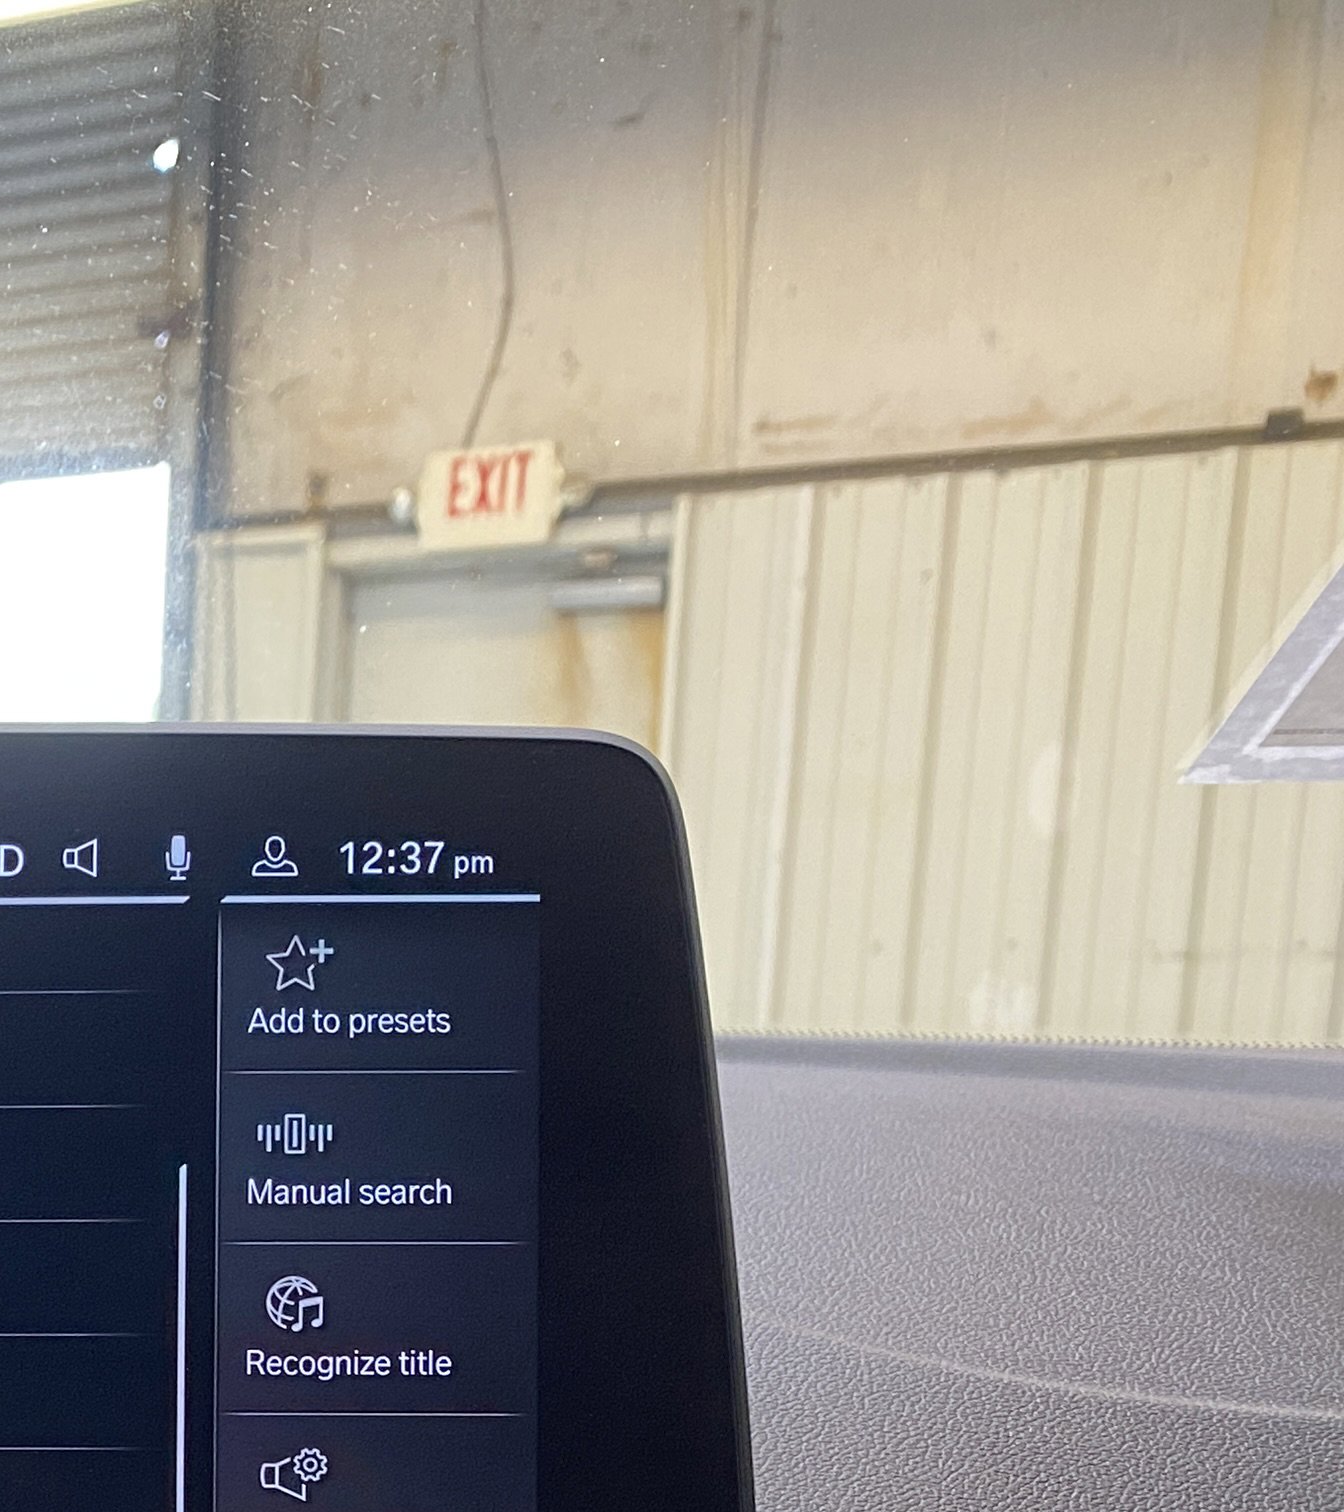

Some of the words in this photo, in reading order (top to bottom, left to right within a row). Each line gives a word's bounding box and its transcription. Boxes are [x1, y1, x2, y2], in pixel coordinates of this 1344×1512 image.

[448, 453, 532, 517] EXIT
[339, 840, 445, 875] 12:37
[454, 855, 494, 880] pm
[247, 1007, 304, 1034] Add
[311, 1008, 341, 1034] to
[349, 1008, 451, 1039] presets
[247, 1177, 350, 1205] Manual
[359, 1177, 452, 1205] search
[246, 1349, 391, 1381] Recognize
[398, 1349, 452, 1376] title
